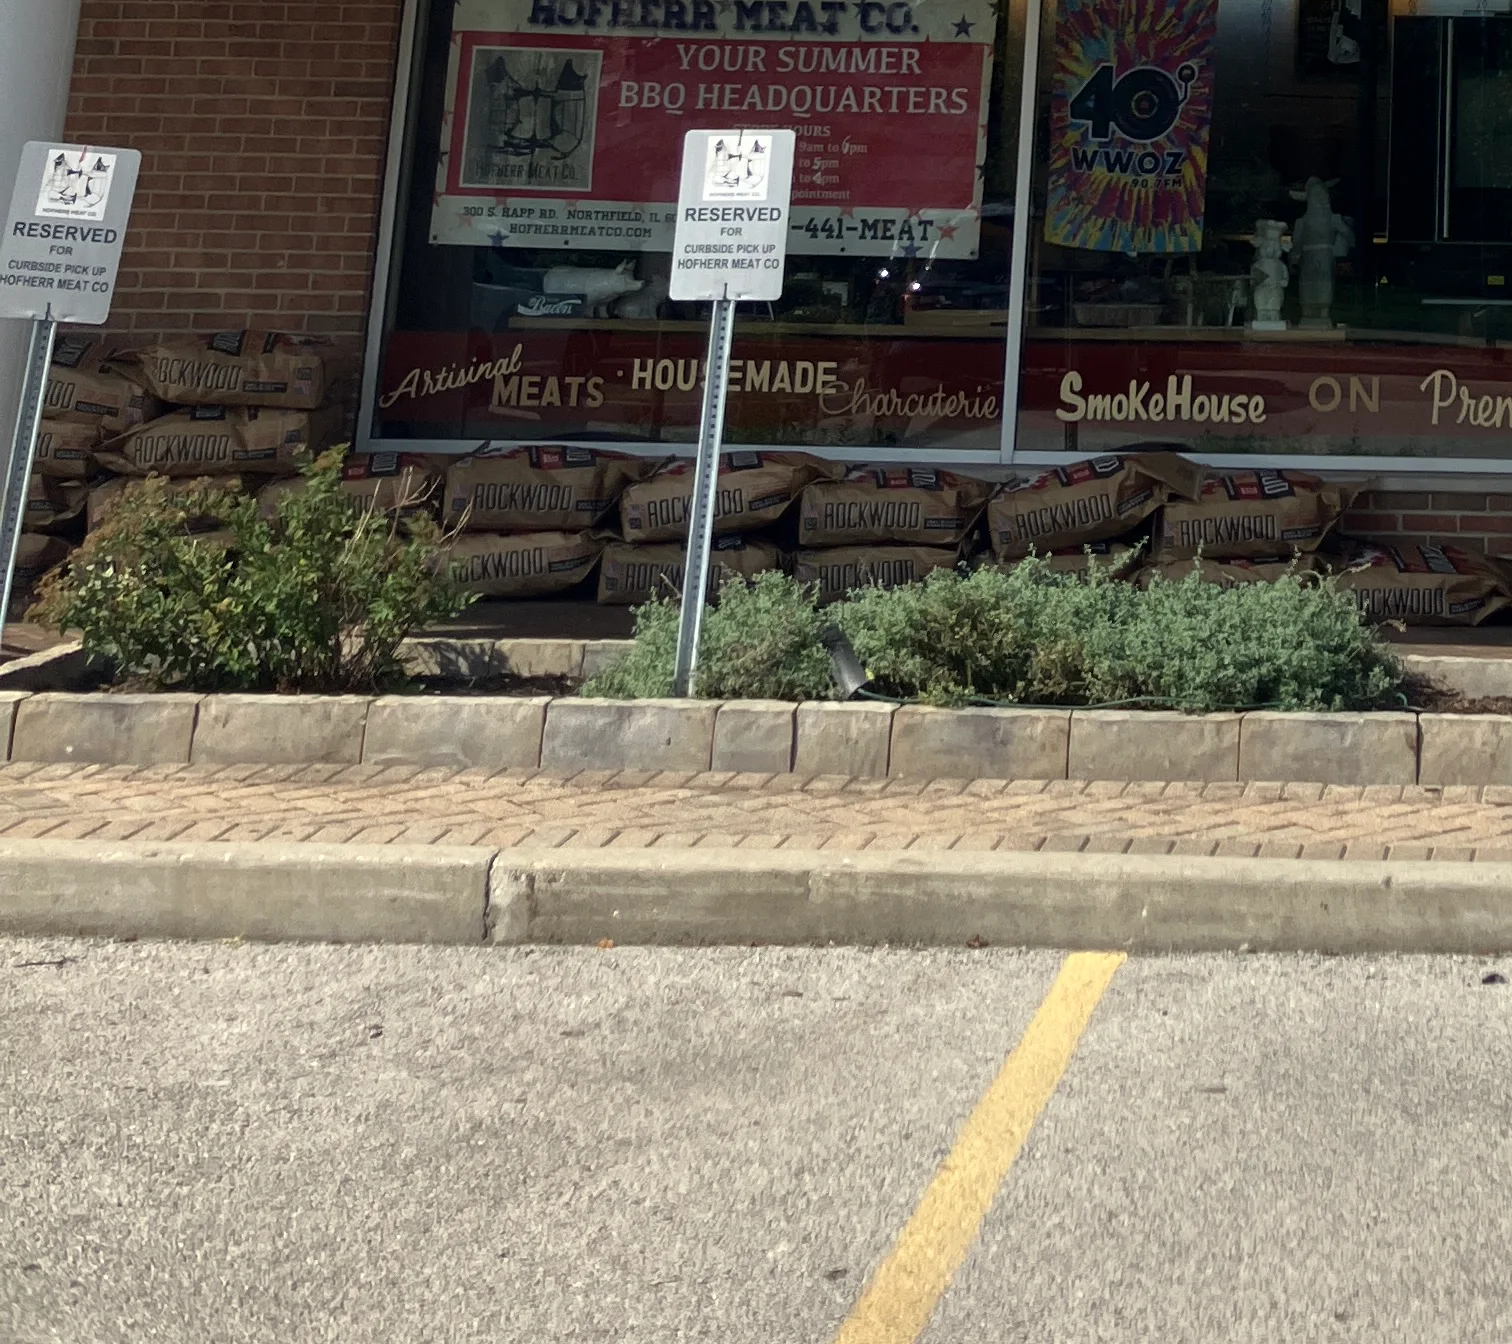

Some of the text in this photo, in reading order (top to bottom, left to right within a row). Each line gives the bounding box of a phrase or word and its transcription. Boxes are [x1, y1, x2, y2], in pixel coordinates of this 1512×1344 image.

[733, 0, 847, 35] MEAT
[860, 2, 919, 34] CO.
[676, 44, 922, 75] YOUR SUMMER
[619, 81, 969, 118] BBQ HEADQUARTERS
[1069, 64, 1184, 143] 40
[790, 124, 831, 137] OURS
[1072, 146, 1185, 175] WWOZ
[684, 207, 782, 222] RESERVED
[12, 221, 117, 244] RESERVED
[509, 223, 652, 238] HOFHERRMEATCO.COM
[720, 227, 743, 237] FOR
[49, 244, 73, 256] FOR
[684, 243, 776, 254] CURBSIDE PICK UP
[8, 259, 107, 276] CURBSIDE PICK UP
[677, 258, 780, 270] HOFHERR MEAT CO
[0, 273, 109, 293] HOFHERR MEAT CO
[379, 343, 1000, 419] Artisinal MEATS HOUEMADE Charcuterie
[1309, 376, 1381, 412] ON
[135, 435, 229, 464] ROCKWOOD
[474, 483, 573, 511] ROCKWOOD
[824, 501, 920, 528] ROCKWOOD
[1016, 494, 1114, 539] ROCKWOOD
[1181, 515, 1277, 548] ROCKWOOD
